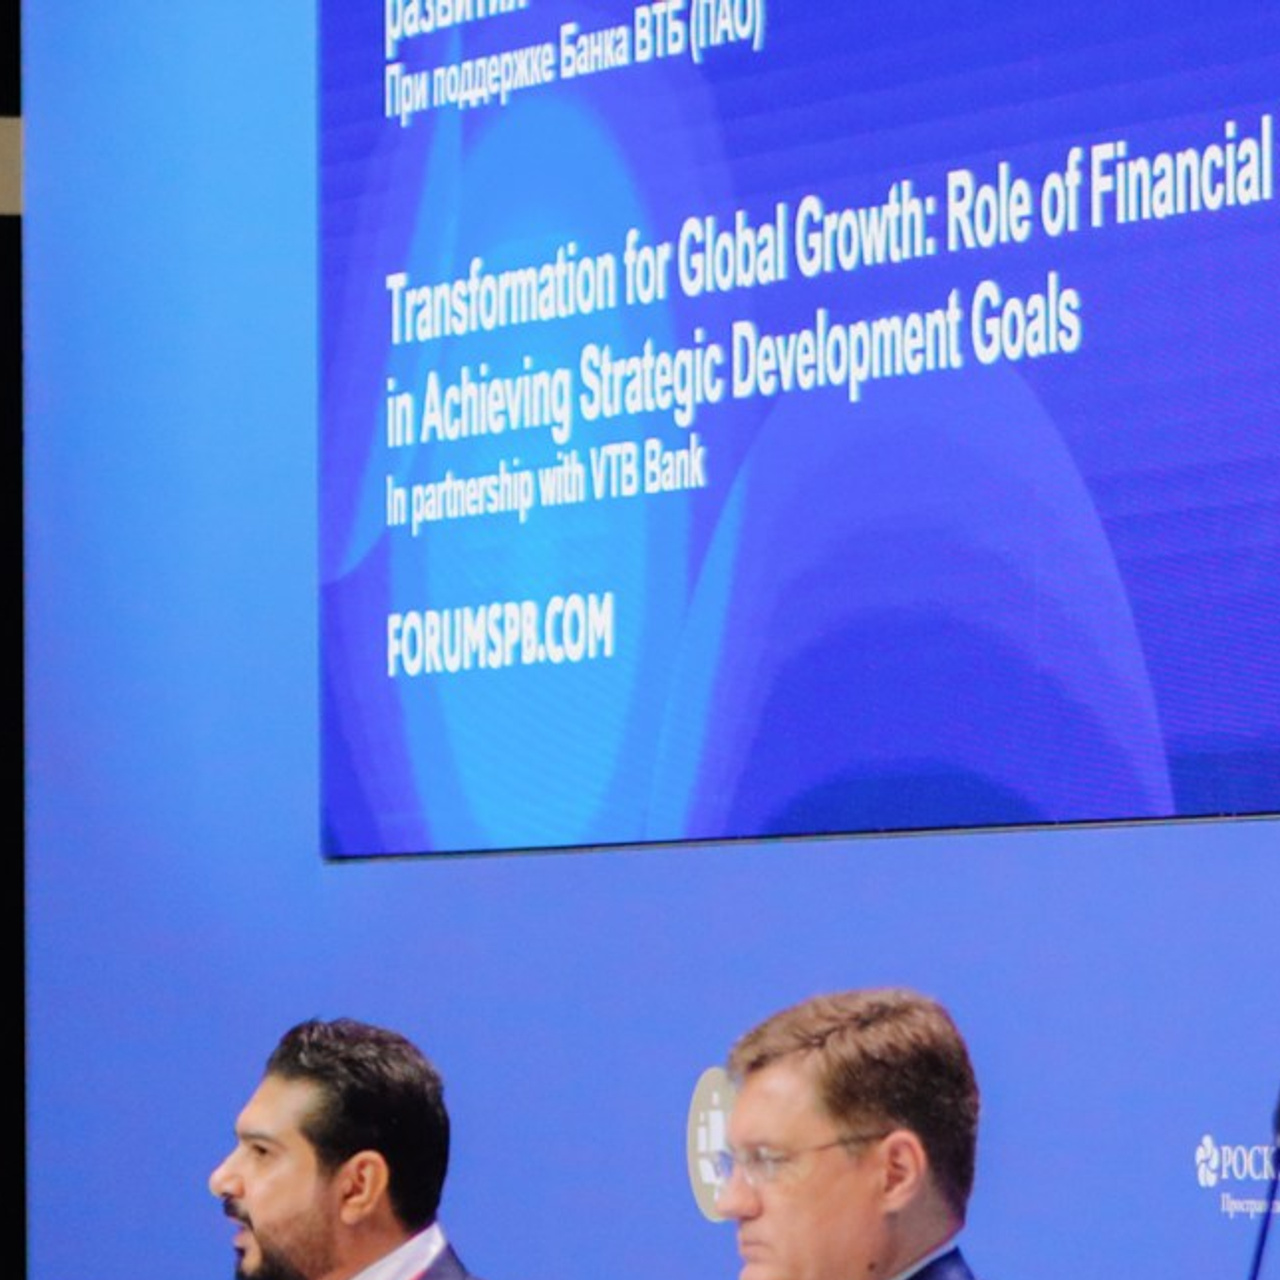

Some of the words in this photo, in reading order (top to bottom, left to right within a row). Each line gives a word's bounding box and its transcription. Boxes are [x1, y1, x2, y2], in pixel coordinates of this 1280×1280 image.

[385, 62, 428, 127] При
[433, 43, 555, 109] поддержке
[560, 22, 630, 79] Банка
[634, 0, 687, 62] ВТБ
[690, 0, 766, 64] (ПАО)
[386, 242, 617, 345] Transformation
[624, 228, 671, 305] for
[678, 202, 788, 297] Global
[795, 178, 937, 279] Growth:
[946, 162, 1032, 253] Role
[1041, 147, 1084, 238] of
[1090, 114, 1273, 229] Financial
[386, 376, 415, 448] in
[421, 356, 573, 444] Achieving
[580, 328, 724, 428] Strategic
[731, 288, 964, 403] Development
[971, 271, 1082, 365] Goals
[386, 473, 407, 527] In
[411, 458, 534, 537] partnership
[538, 450, 586, 508] with
[589, 440, 639, 500] VTB
[644, 431, 707, 495] Bank
[387, 591, 614, 678] FORUMSPB.COM
